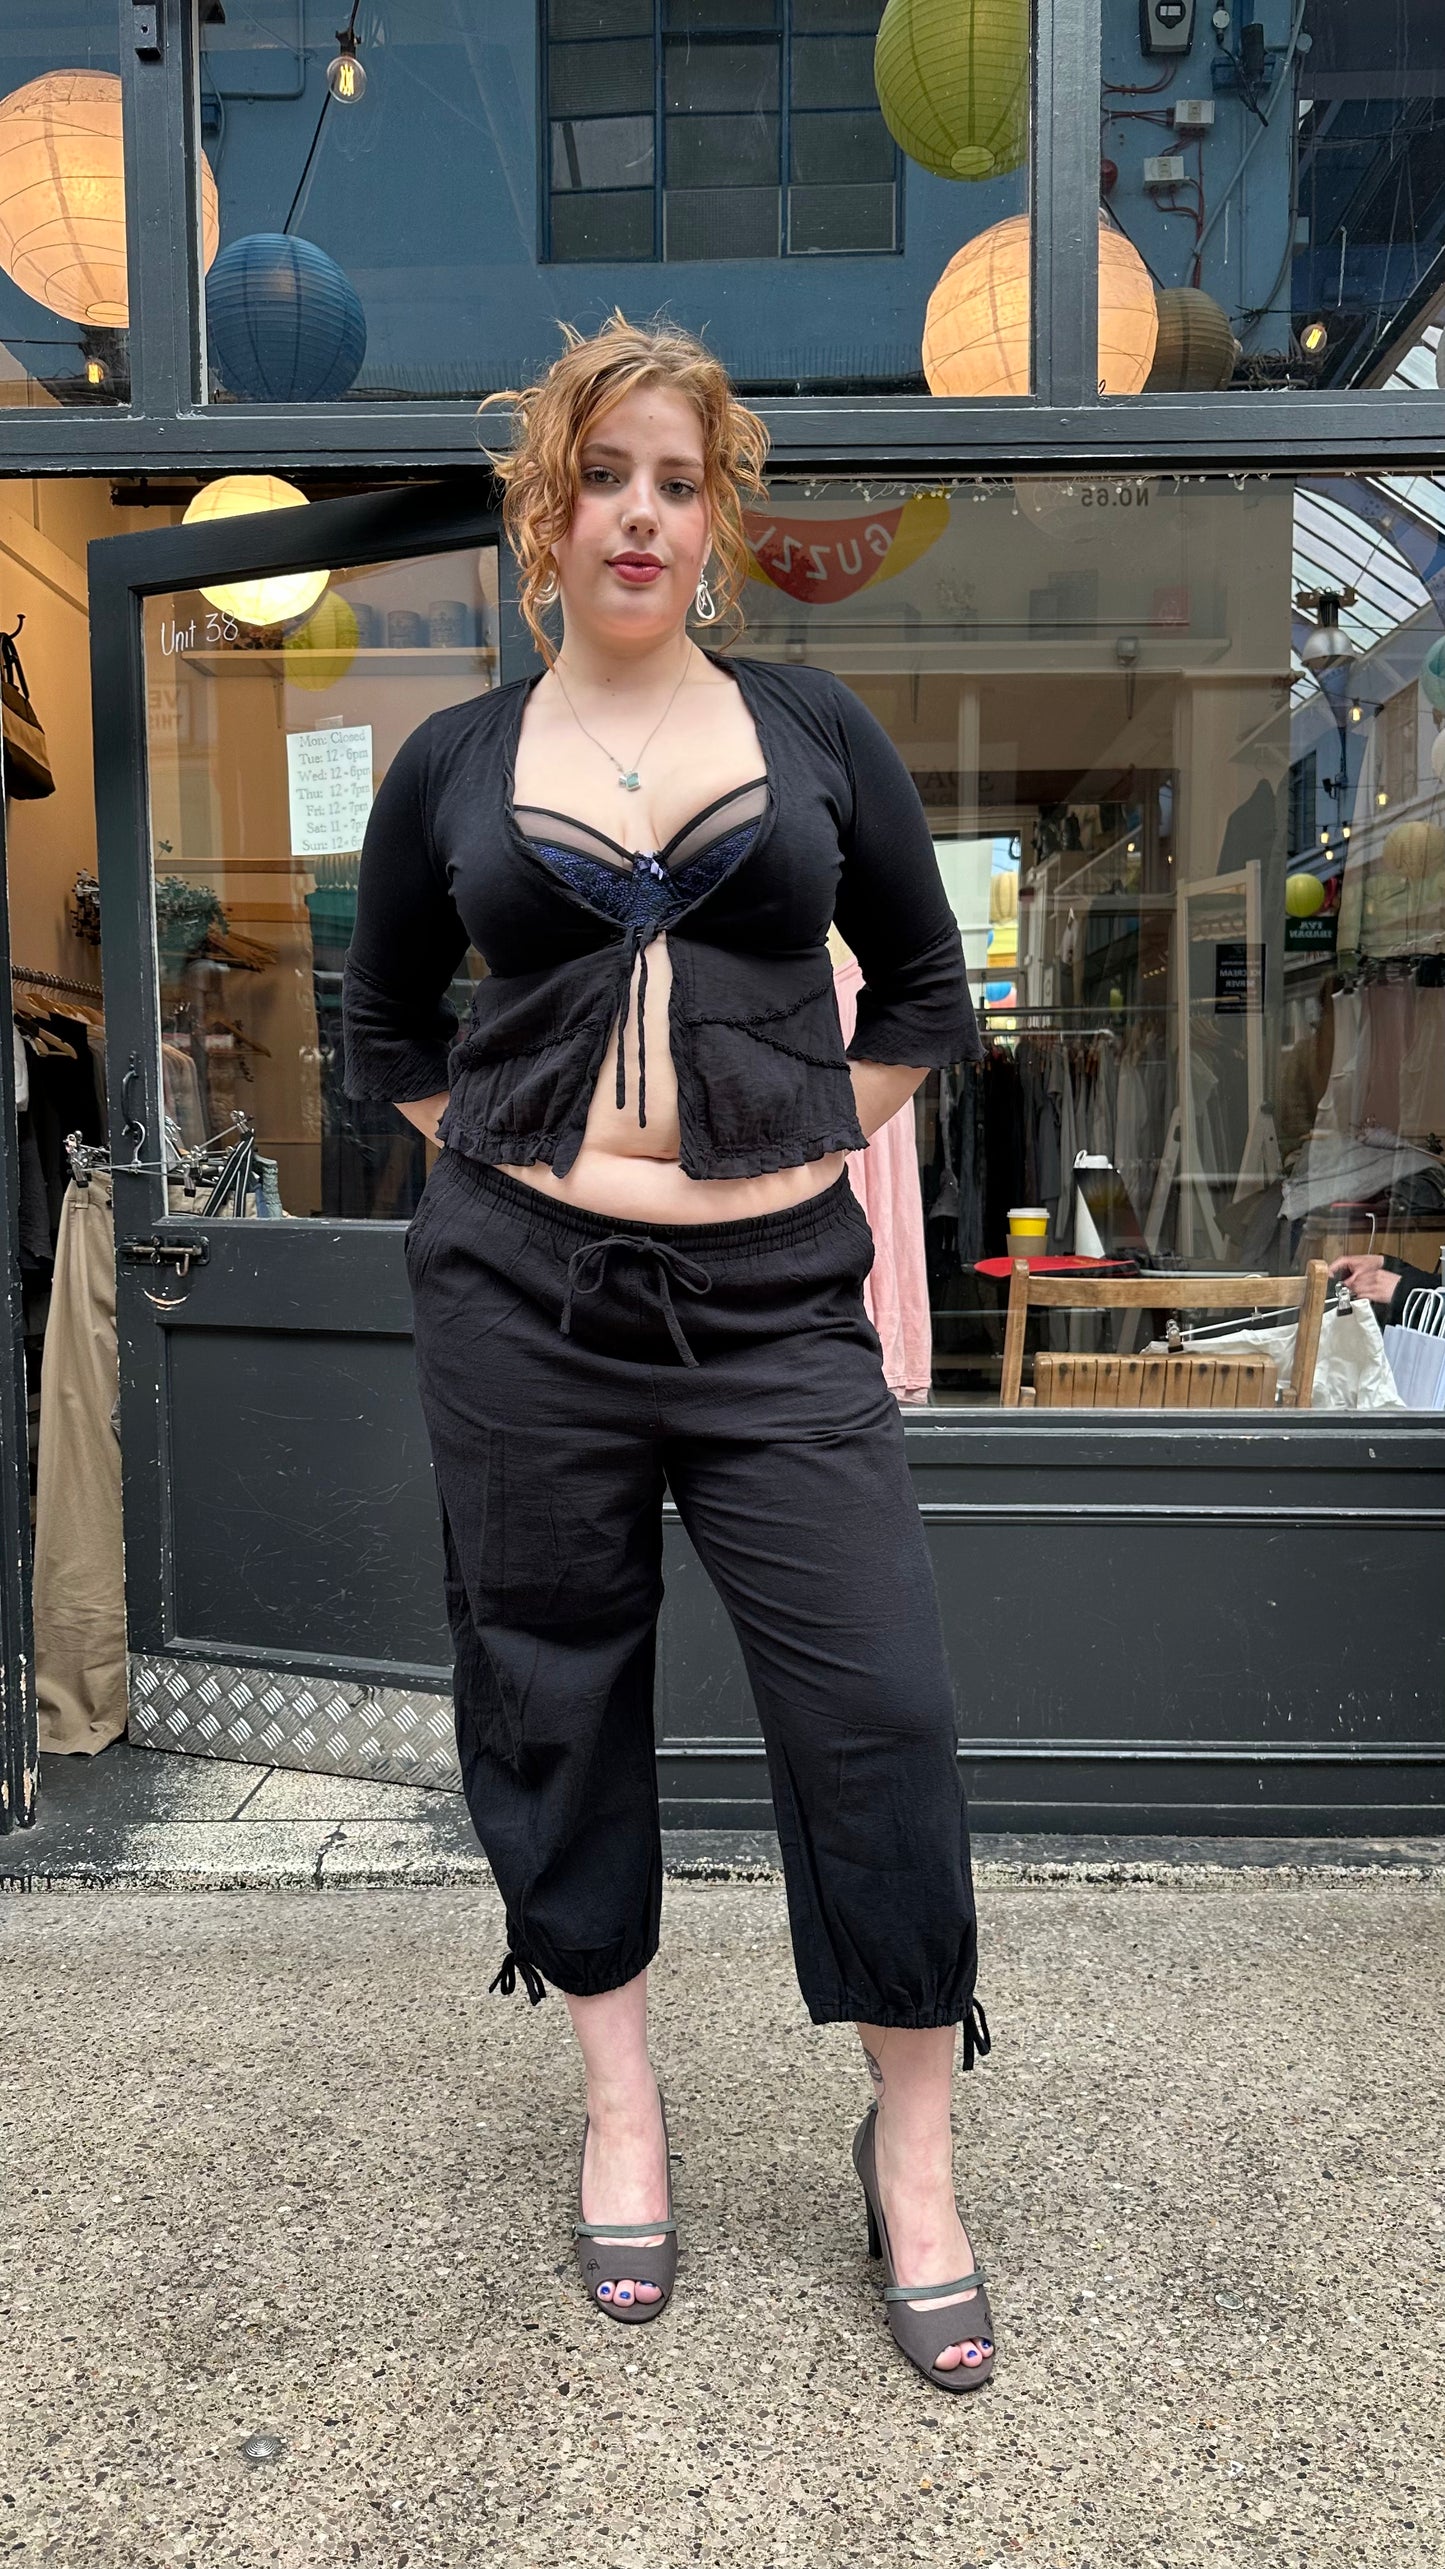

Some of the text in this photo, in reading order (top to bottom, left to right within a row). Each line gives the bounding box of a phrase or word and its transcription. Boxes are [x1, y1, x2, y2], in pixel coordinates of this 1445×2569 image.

[161, 609, 239, 656] Unit 38
[299, 729, 366, 748] Mon: Closed
[298, 753, 323, 765] Tue:
[297, 768, 328, 782] Wed:
[296, 787, 324, 800] Thu:
[306, 804, 326, 816] Fri:
[306, 822, 327, 834] Sat:
[302, 839, 328, 851] Sun:
